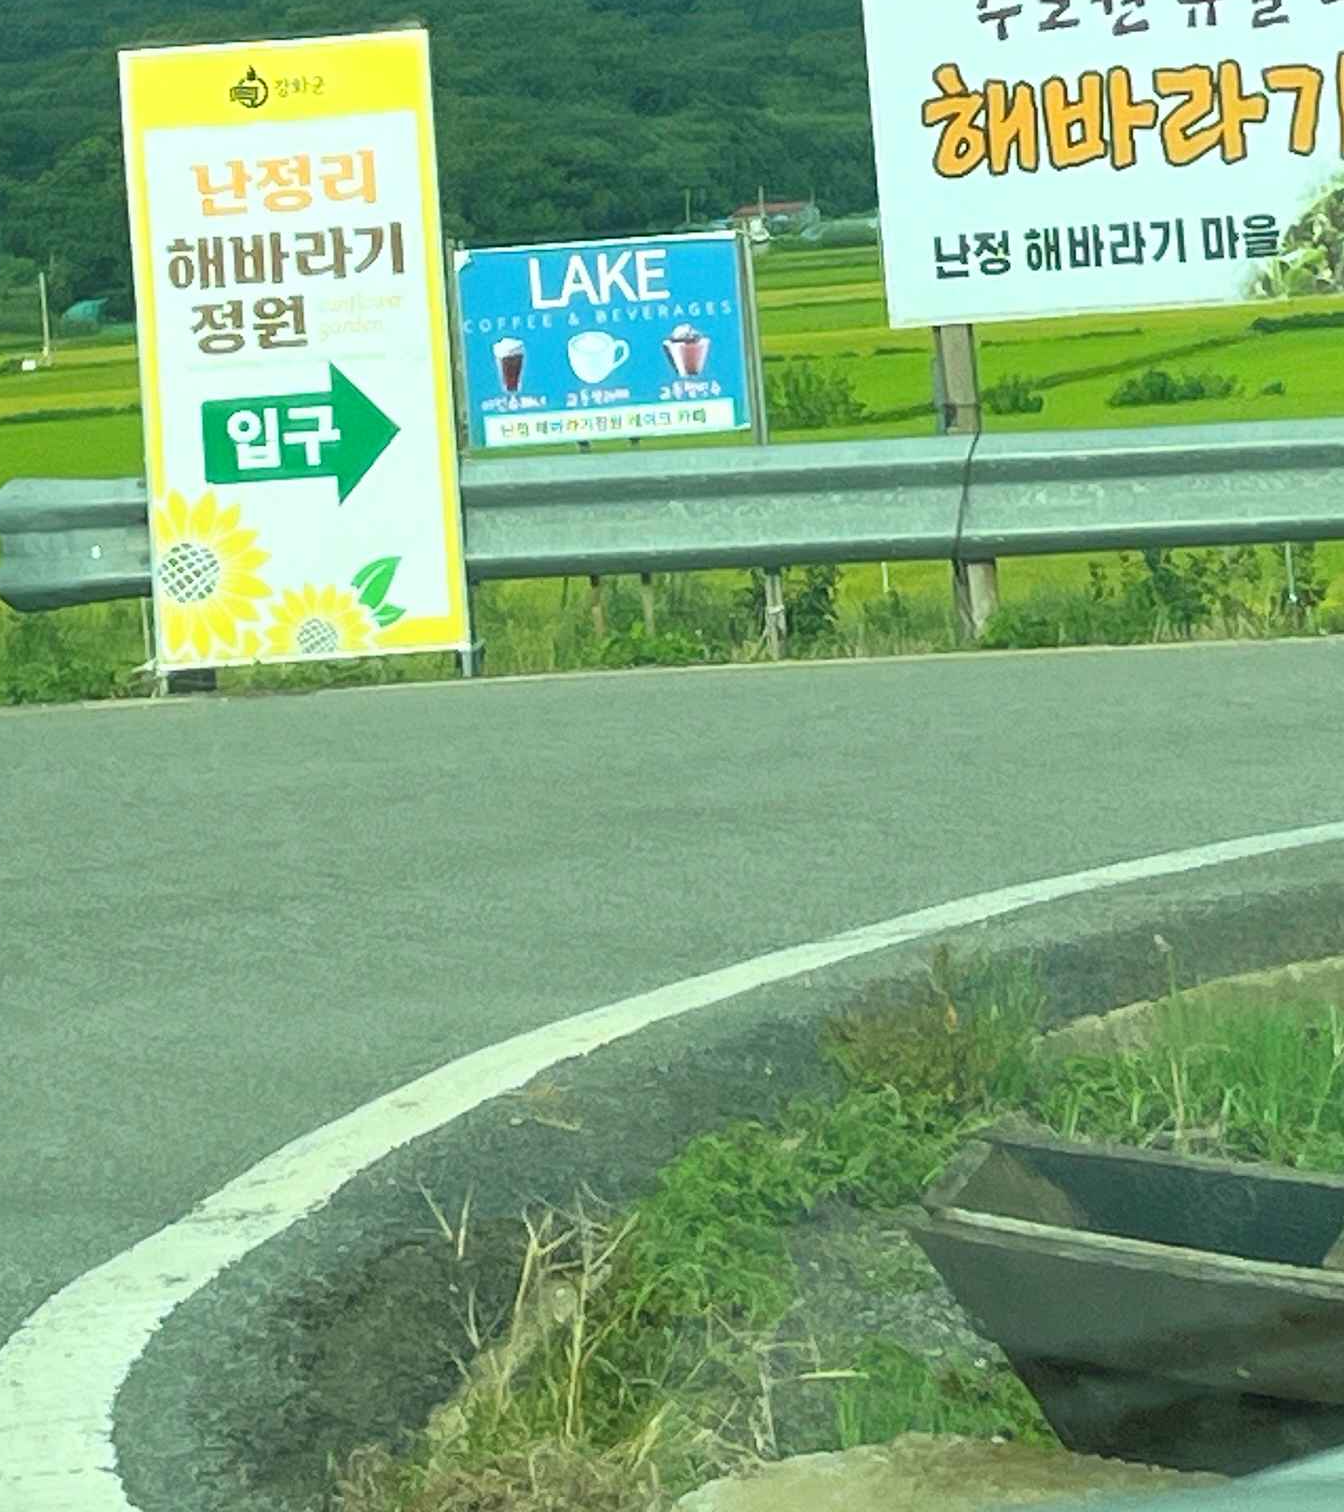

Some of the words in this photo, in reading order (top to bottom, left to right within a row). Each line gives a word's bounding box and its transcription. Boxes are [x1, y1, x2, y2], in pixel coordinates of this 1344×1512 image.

[190, 149, 379, 218] 난정리
[167, 221, 406, 292] 해바라기
[933, 230, 1010, 279] 난정
[1024, 219, 1187, 271] 해바라기
[1201, 213, 1280, 260] 마을
[528, 248, 671, 310] LAKE
[190, 294, 308, 354] 정원
[462, 313, 553, 334] COFFEE
[567, 312, 581, 327] &
[596, 299, 733, 323] BEVERAGES
[226, 406, 341, 470] 입구
